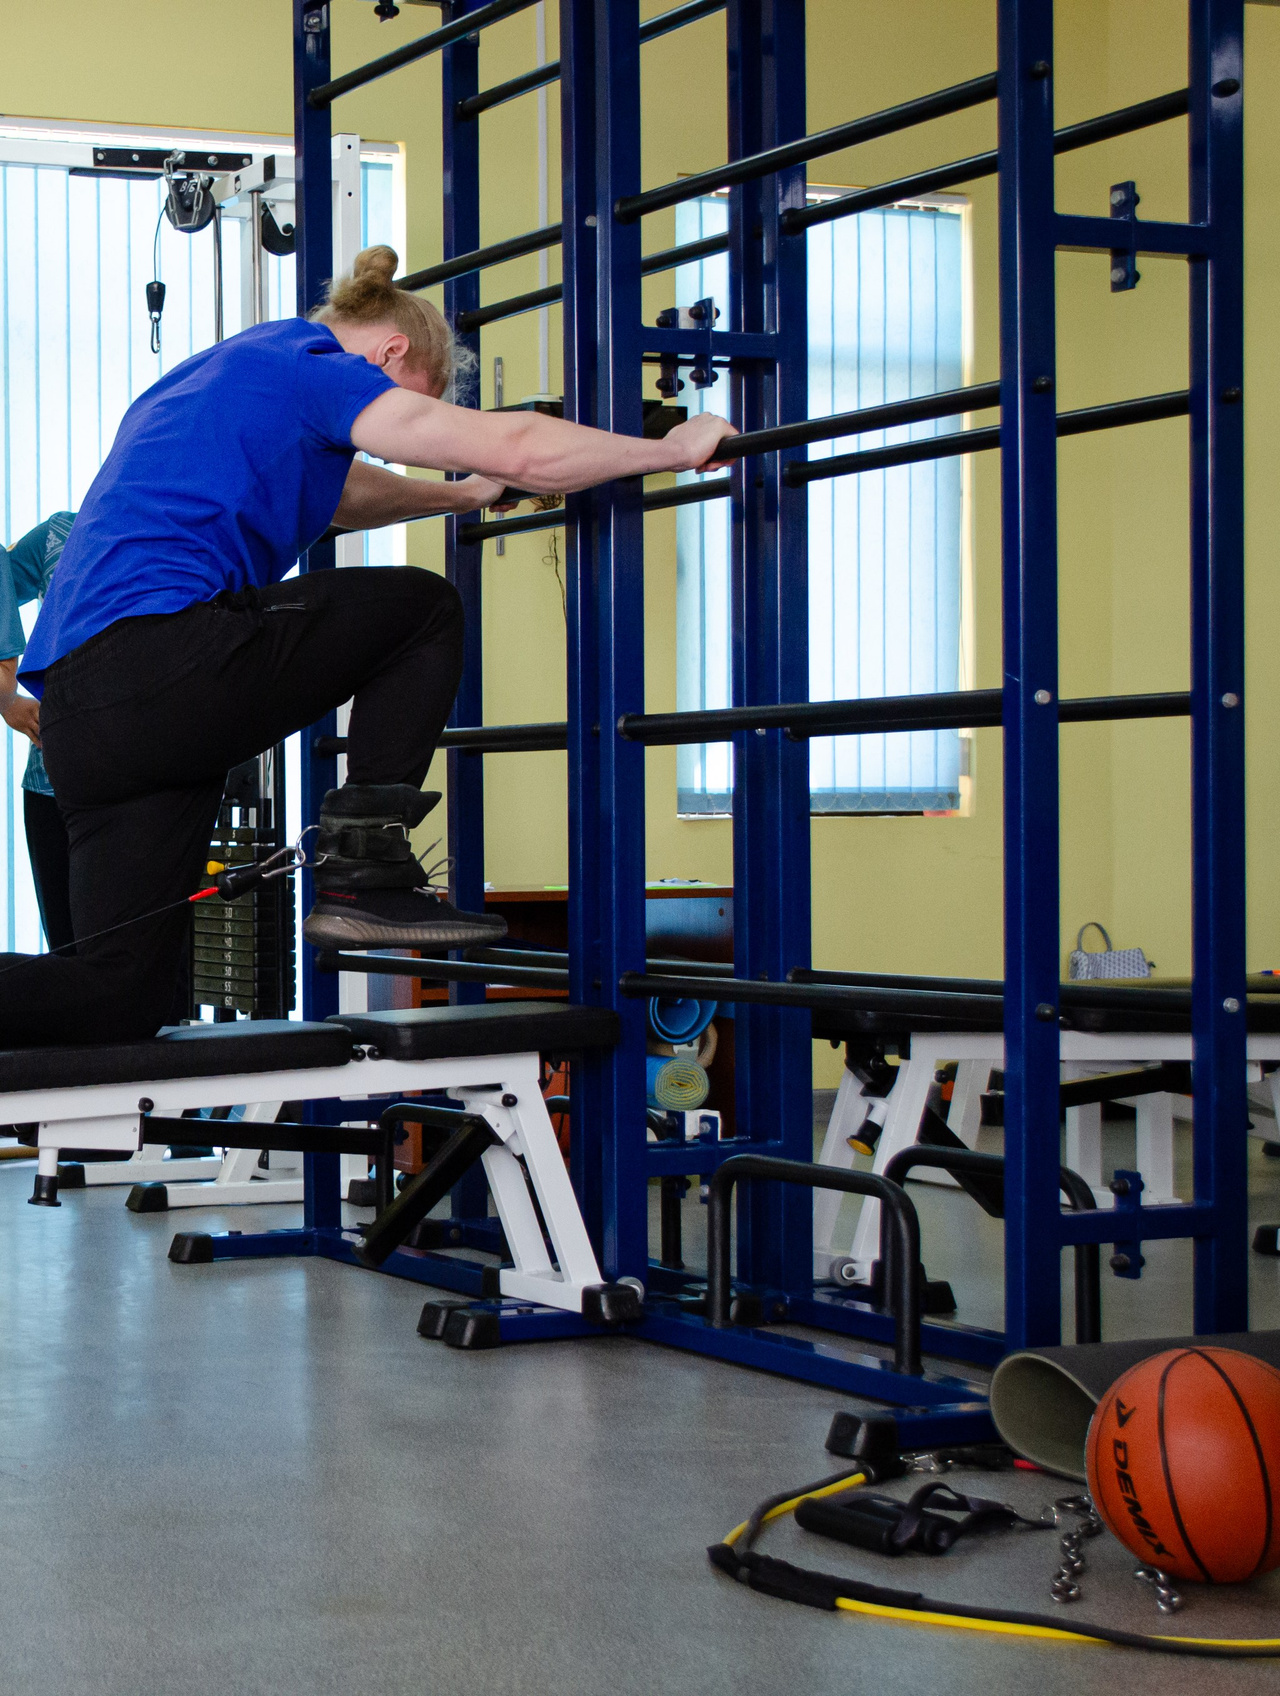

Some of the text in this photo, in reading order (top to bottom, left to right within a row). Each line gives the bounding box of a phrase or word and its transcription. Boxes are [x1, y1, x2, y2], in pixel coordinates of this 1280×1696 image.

[224, 981, 232, 992] 55
[224, 996, 233, 1006] 60
[1113, 1438, 1177, 1559] DEMIX
